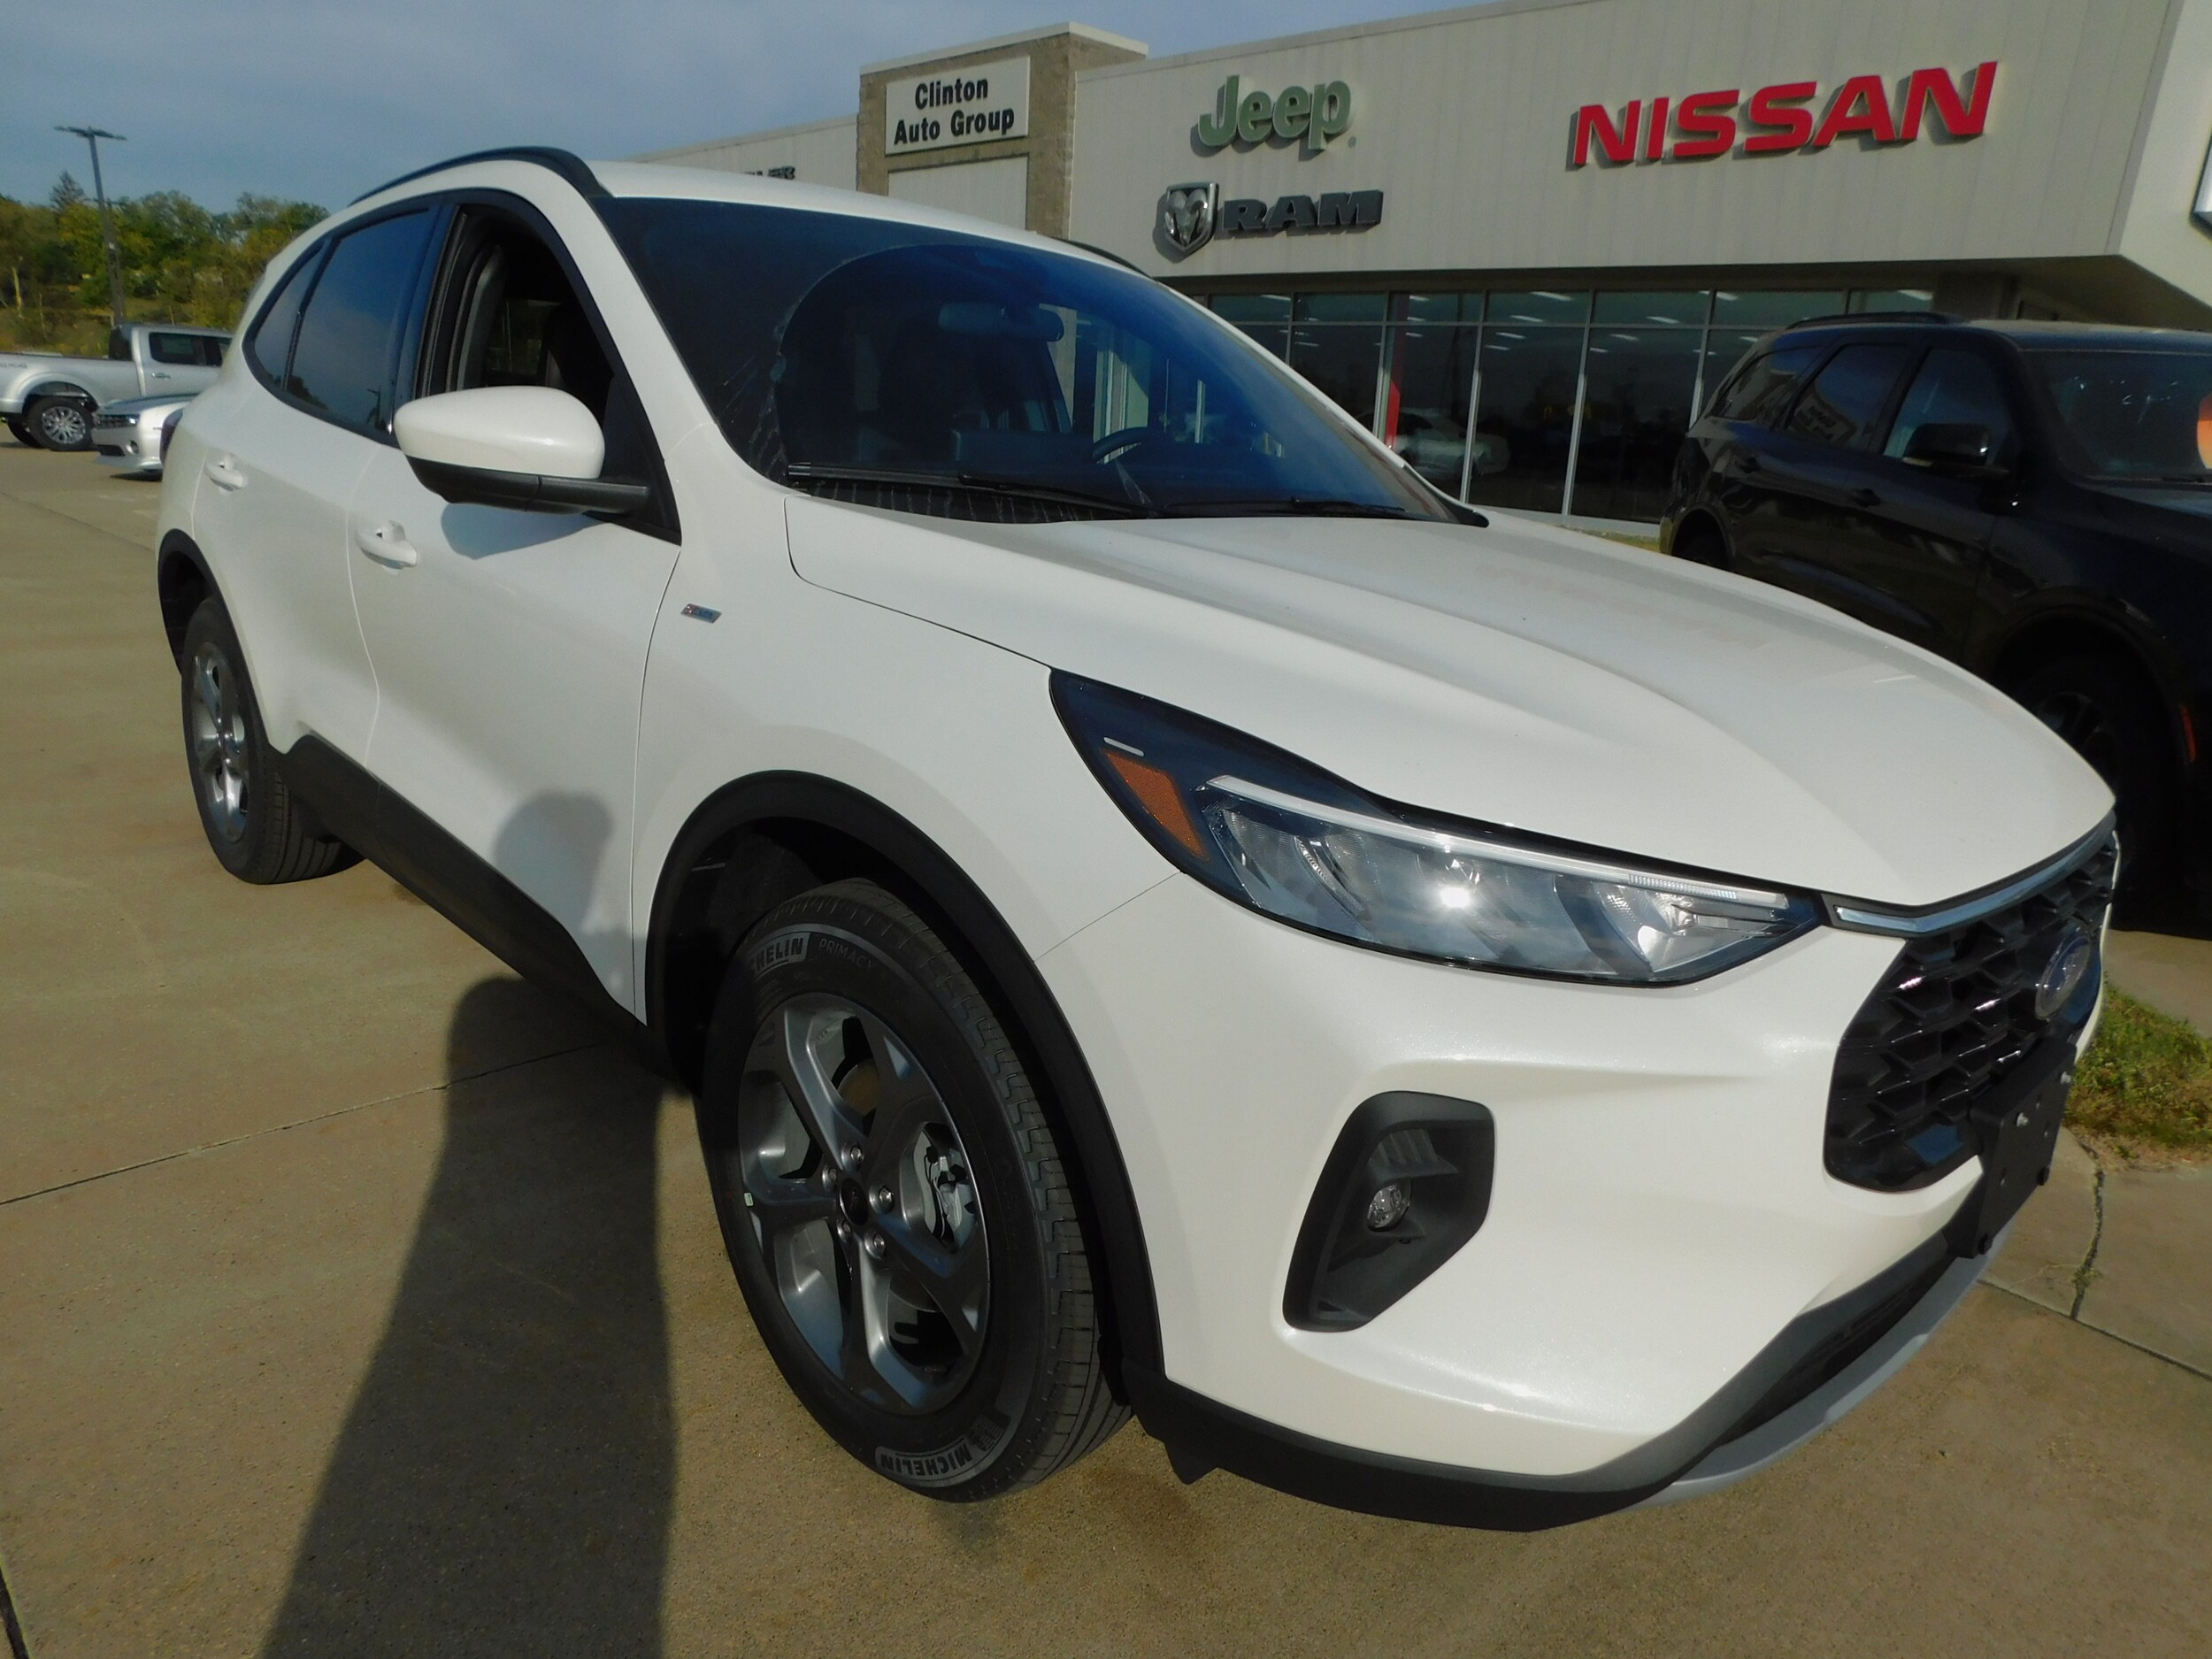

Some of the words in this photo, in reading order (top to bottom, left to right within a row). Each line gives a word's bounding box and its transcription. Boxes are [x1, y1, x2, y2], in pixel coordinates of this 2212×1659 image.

[915, 78, 988, 110] Clinton
[1198, 74, 1351, 150] Jeep
[894, 119, 941, 145] Auto
[950, 108, 1015, 136] Group
[1574, 61, 1998, 165] NISSAN
[1223, 189, 1384, 230] RAM
[750, 937, 803, 972] HELIN
[880, 1444, 972, 1477] MICHELIN
